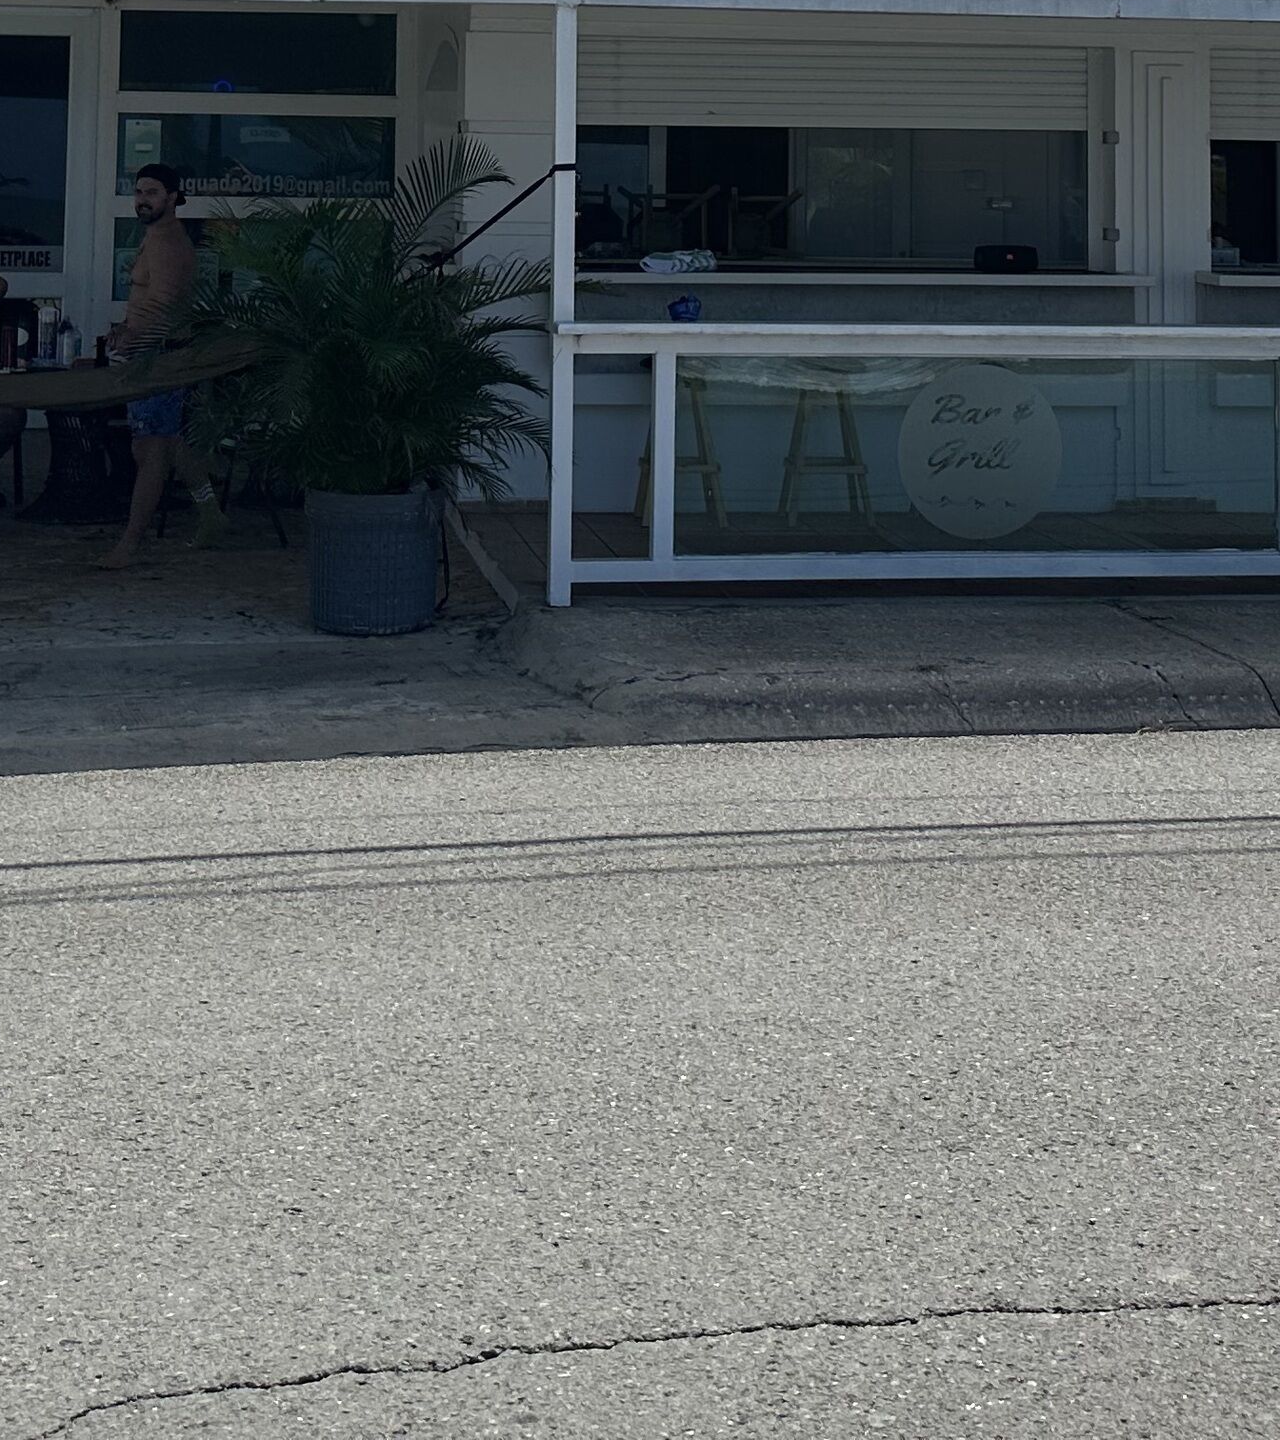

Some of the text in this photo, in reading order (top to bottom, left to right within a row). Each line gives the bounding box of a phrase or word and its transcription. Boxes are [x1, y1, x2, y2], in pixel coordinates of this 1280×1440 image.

[120, 174, 391, 196] maguada2019@gmail.com
[930, 393, 1002, 425] Bar
[927, 439, 1020, 475] Grill
